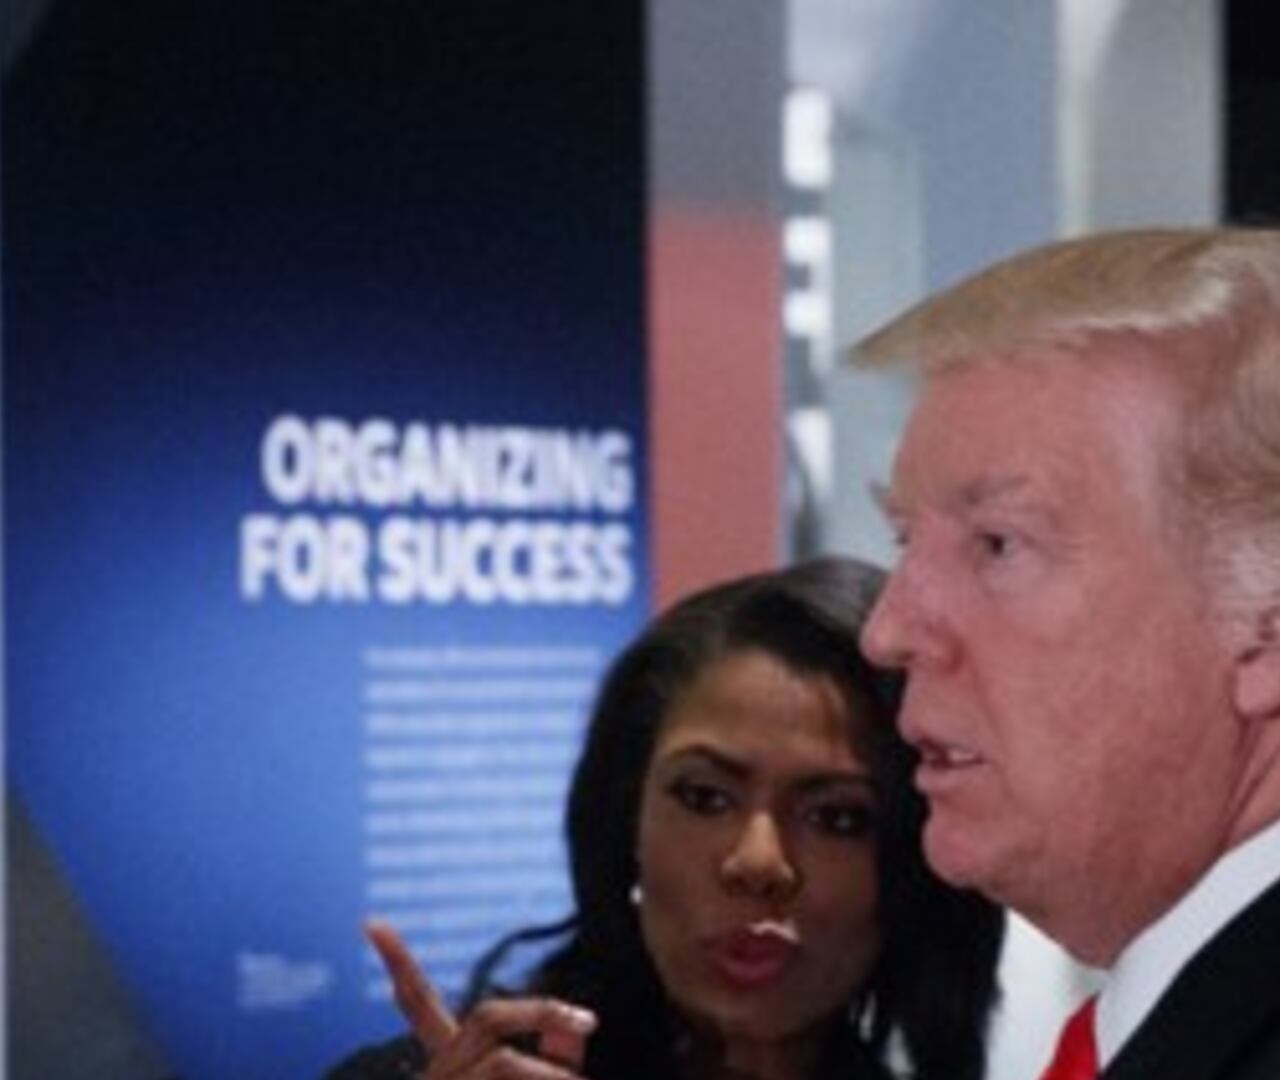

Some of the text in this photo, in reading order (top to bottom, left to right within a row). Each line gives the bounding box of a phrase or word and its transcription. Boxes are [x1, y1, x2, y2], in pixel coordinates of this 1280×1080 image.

[260, 414, 634, 512] ORGANIZING
[239, 514, 634, 607] FOR SUCCESS
